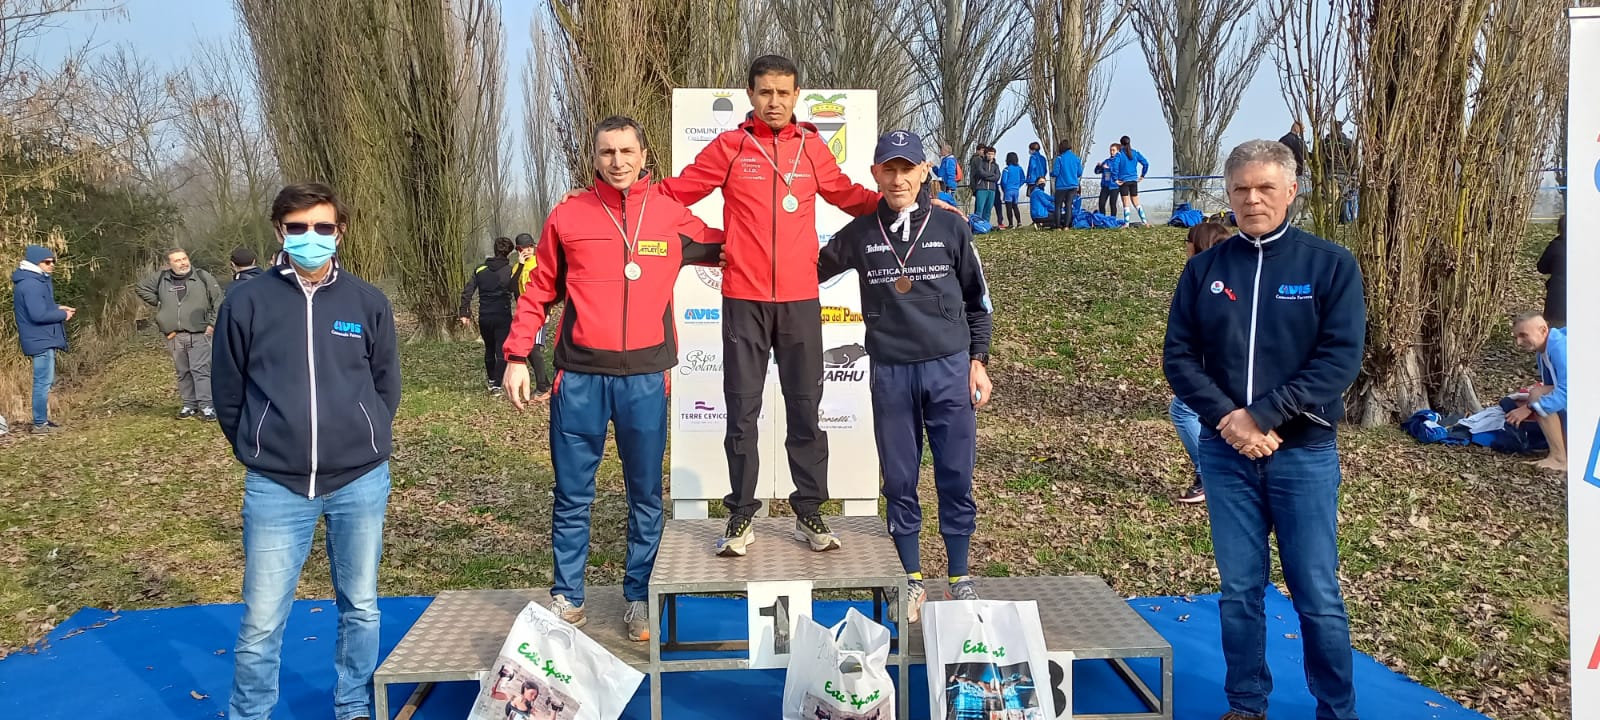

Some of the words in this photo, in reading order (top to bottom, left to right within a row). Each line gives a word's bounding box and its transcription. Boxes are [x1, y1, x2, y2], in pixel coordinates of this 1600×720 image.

[866, 268, 901, 278] ATLETICA
[903, 266, 927, 275] RIMINI
[928, 265, 950, 273] NORD
[1278, 284, 1312, 295] AVIS
[684, 308, 720, 320] AVIS
[333, 320, 362, 334] AVIS
[962, 639, 988, 654] Este
[541, 659, 572, 684] Sport
[824, 680, 847, 703] Este
[850, 689, 880, 710] Sport
